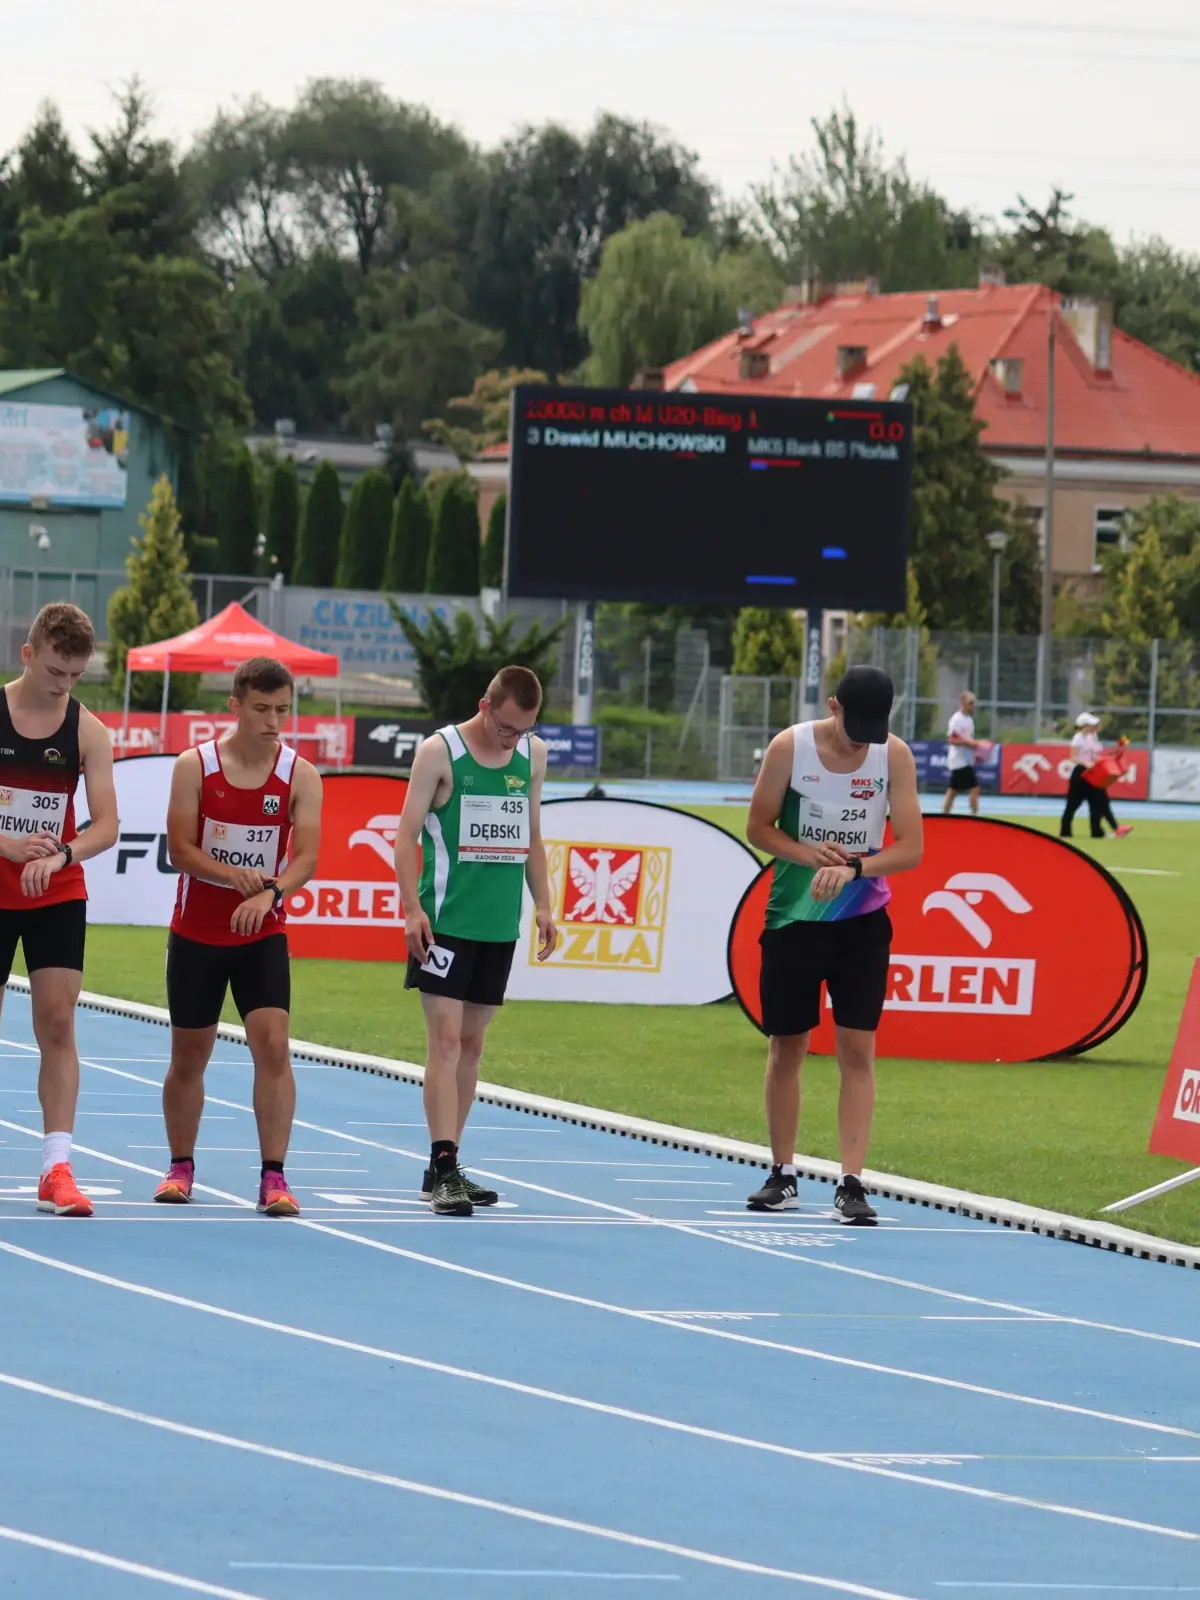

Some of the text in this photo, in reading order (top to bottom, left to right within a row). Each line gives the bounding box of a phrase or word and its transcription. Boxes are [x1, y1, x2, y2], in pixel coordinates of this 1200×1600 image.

[610, 403, 630, 423] ch
[526, 427, 726, 453] 3 Dawid MUCHOWSKI
[869, 421, 905, 441] 0.0
[111, 727, 160, 748] RLEN
[368, 724, 402, 744] 4F
[851, 778, 872, 787] MKS
[31, 795, 59, 810] 305
[500, 800, 523, 814] 435
[840, 808, 867, 822] 254
[246, 829, 273, 843] 317
[470, 823, 520, 841] DĘBSKI
[801, 824, 867, 844] JASIORSKI
[210, 847, 265, 868] SROKA
[284, 888, 404, 918] ORLE
[427, 951, 449, 970] 2
[885, 964, 1020, 1006] RLEN
